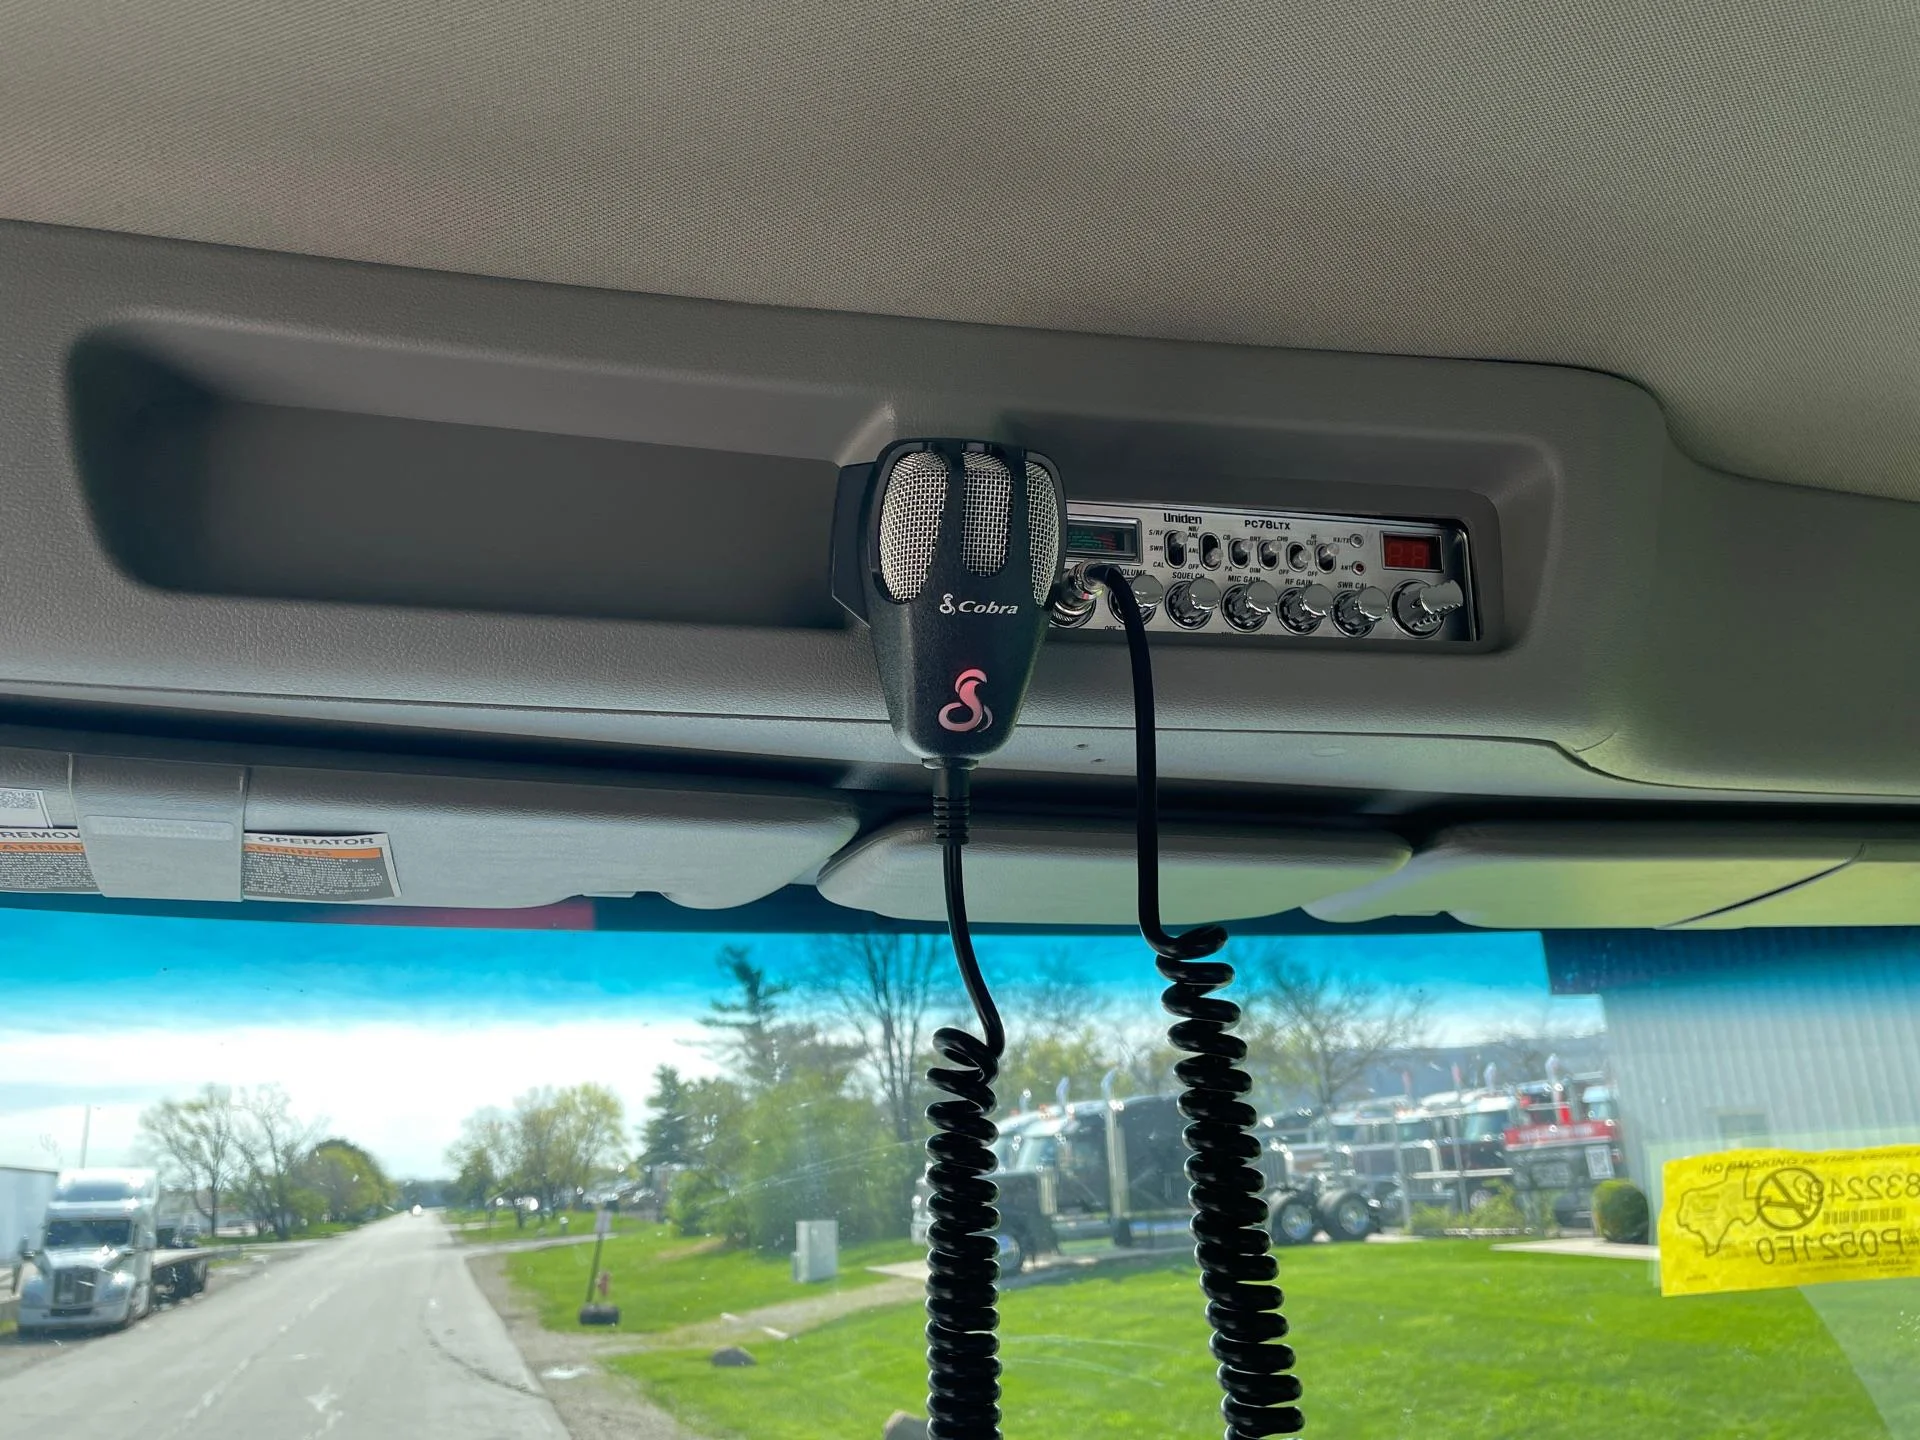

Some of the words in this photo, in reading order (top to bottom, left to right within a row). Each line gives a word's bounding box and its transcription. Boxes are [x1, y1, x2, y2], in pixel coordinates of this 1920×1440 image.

[1164, 513, 1202, 524] Uniden
[1244, 519, 1291, 530] PC78LTX
[1121, 568, 1147, 576] OLUME
[1243, 575, 1261, 583] GAIN
[1296, 579, 1314, 587] GAIN
[958, 600, 1019, 615] Cobra
[258, 836, 375, 845] OPERATOR
[1702, 1162, 1724, 1175] NO
